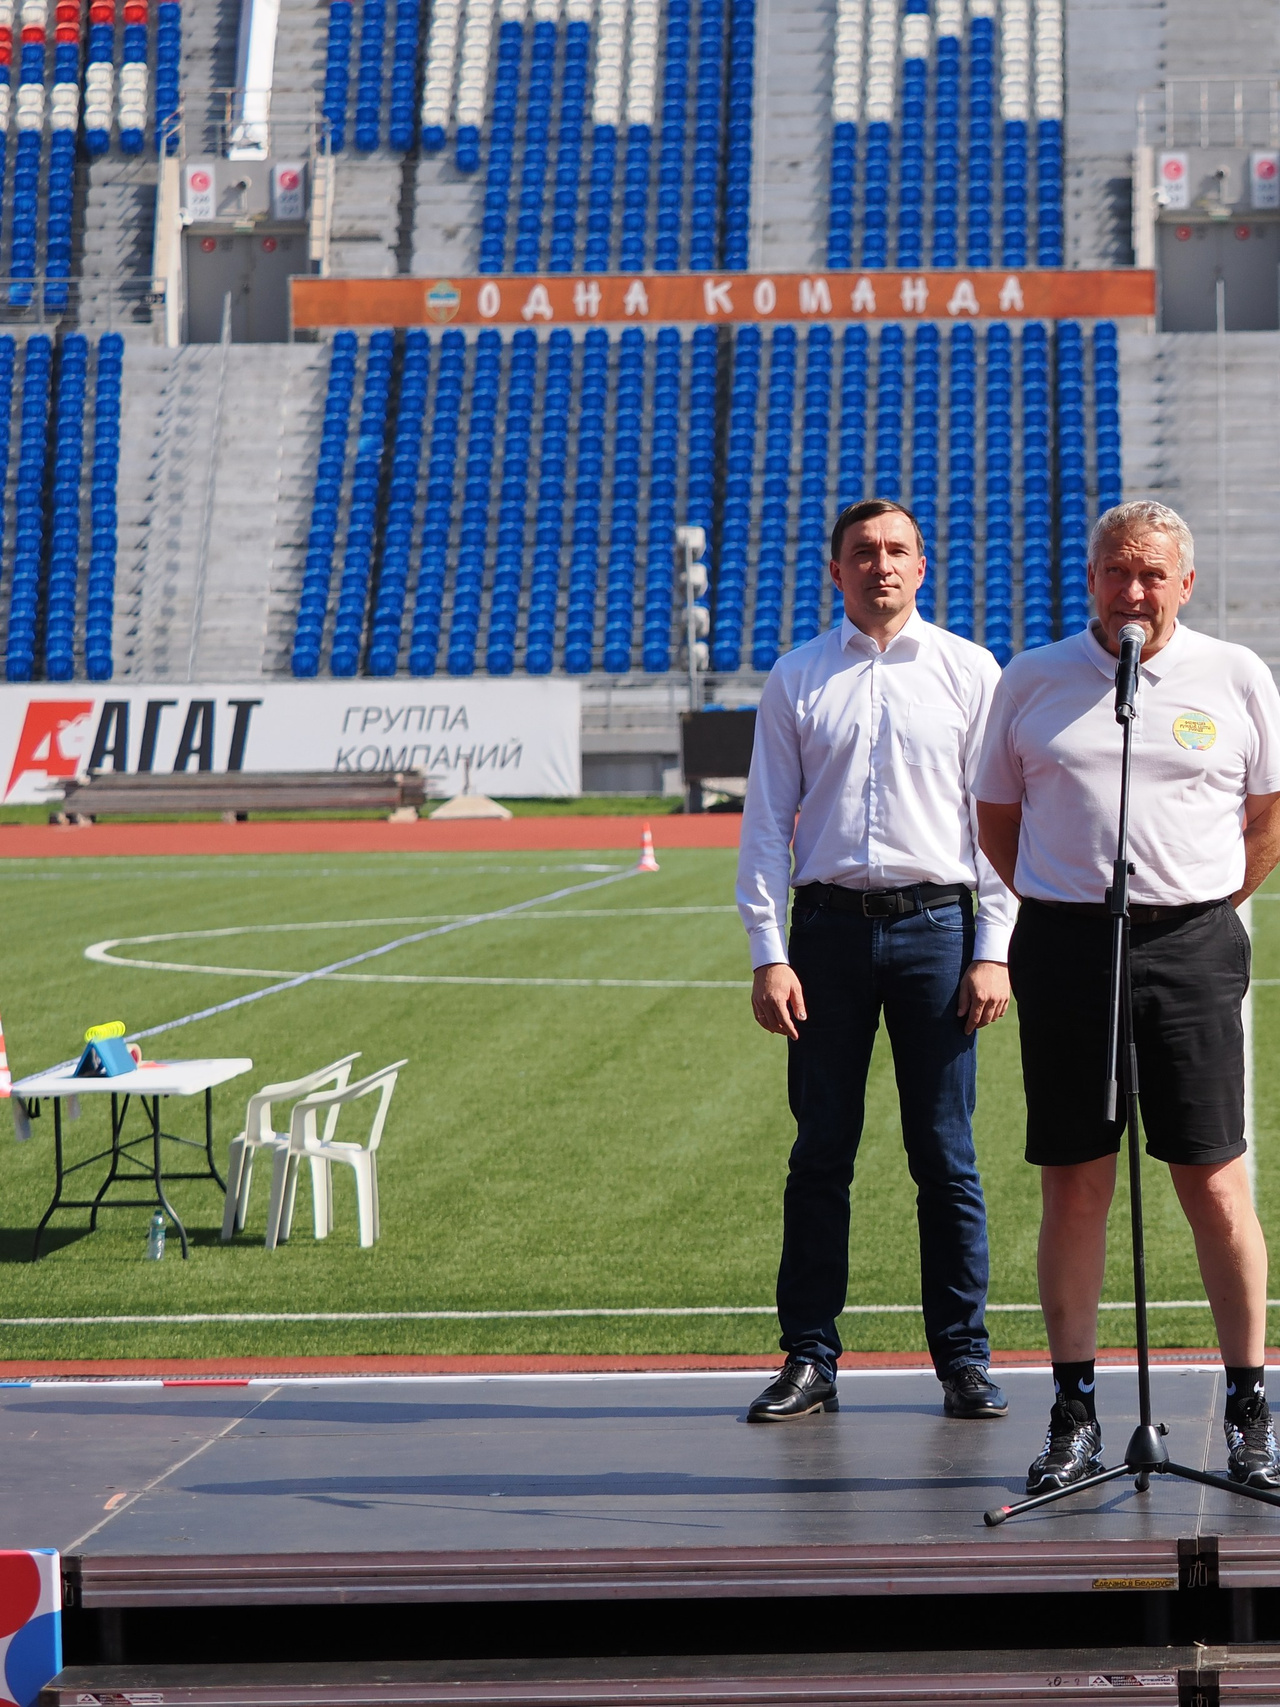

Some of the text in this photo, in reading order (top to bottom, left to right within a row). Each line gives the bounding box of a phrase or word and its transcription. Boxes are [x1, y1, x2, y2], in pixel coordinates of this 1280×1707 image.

[477, 275, 1025, 321] ОДНА КОМАНДА
[87, 699, 263, 773] АГАТ
[342, 705, 469, 734] ГРУППА
[334, 736, 523, 773] КОМПАНИЙ
